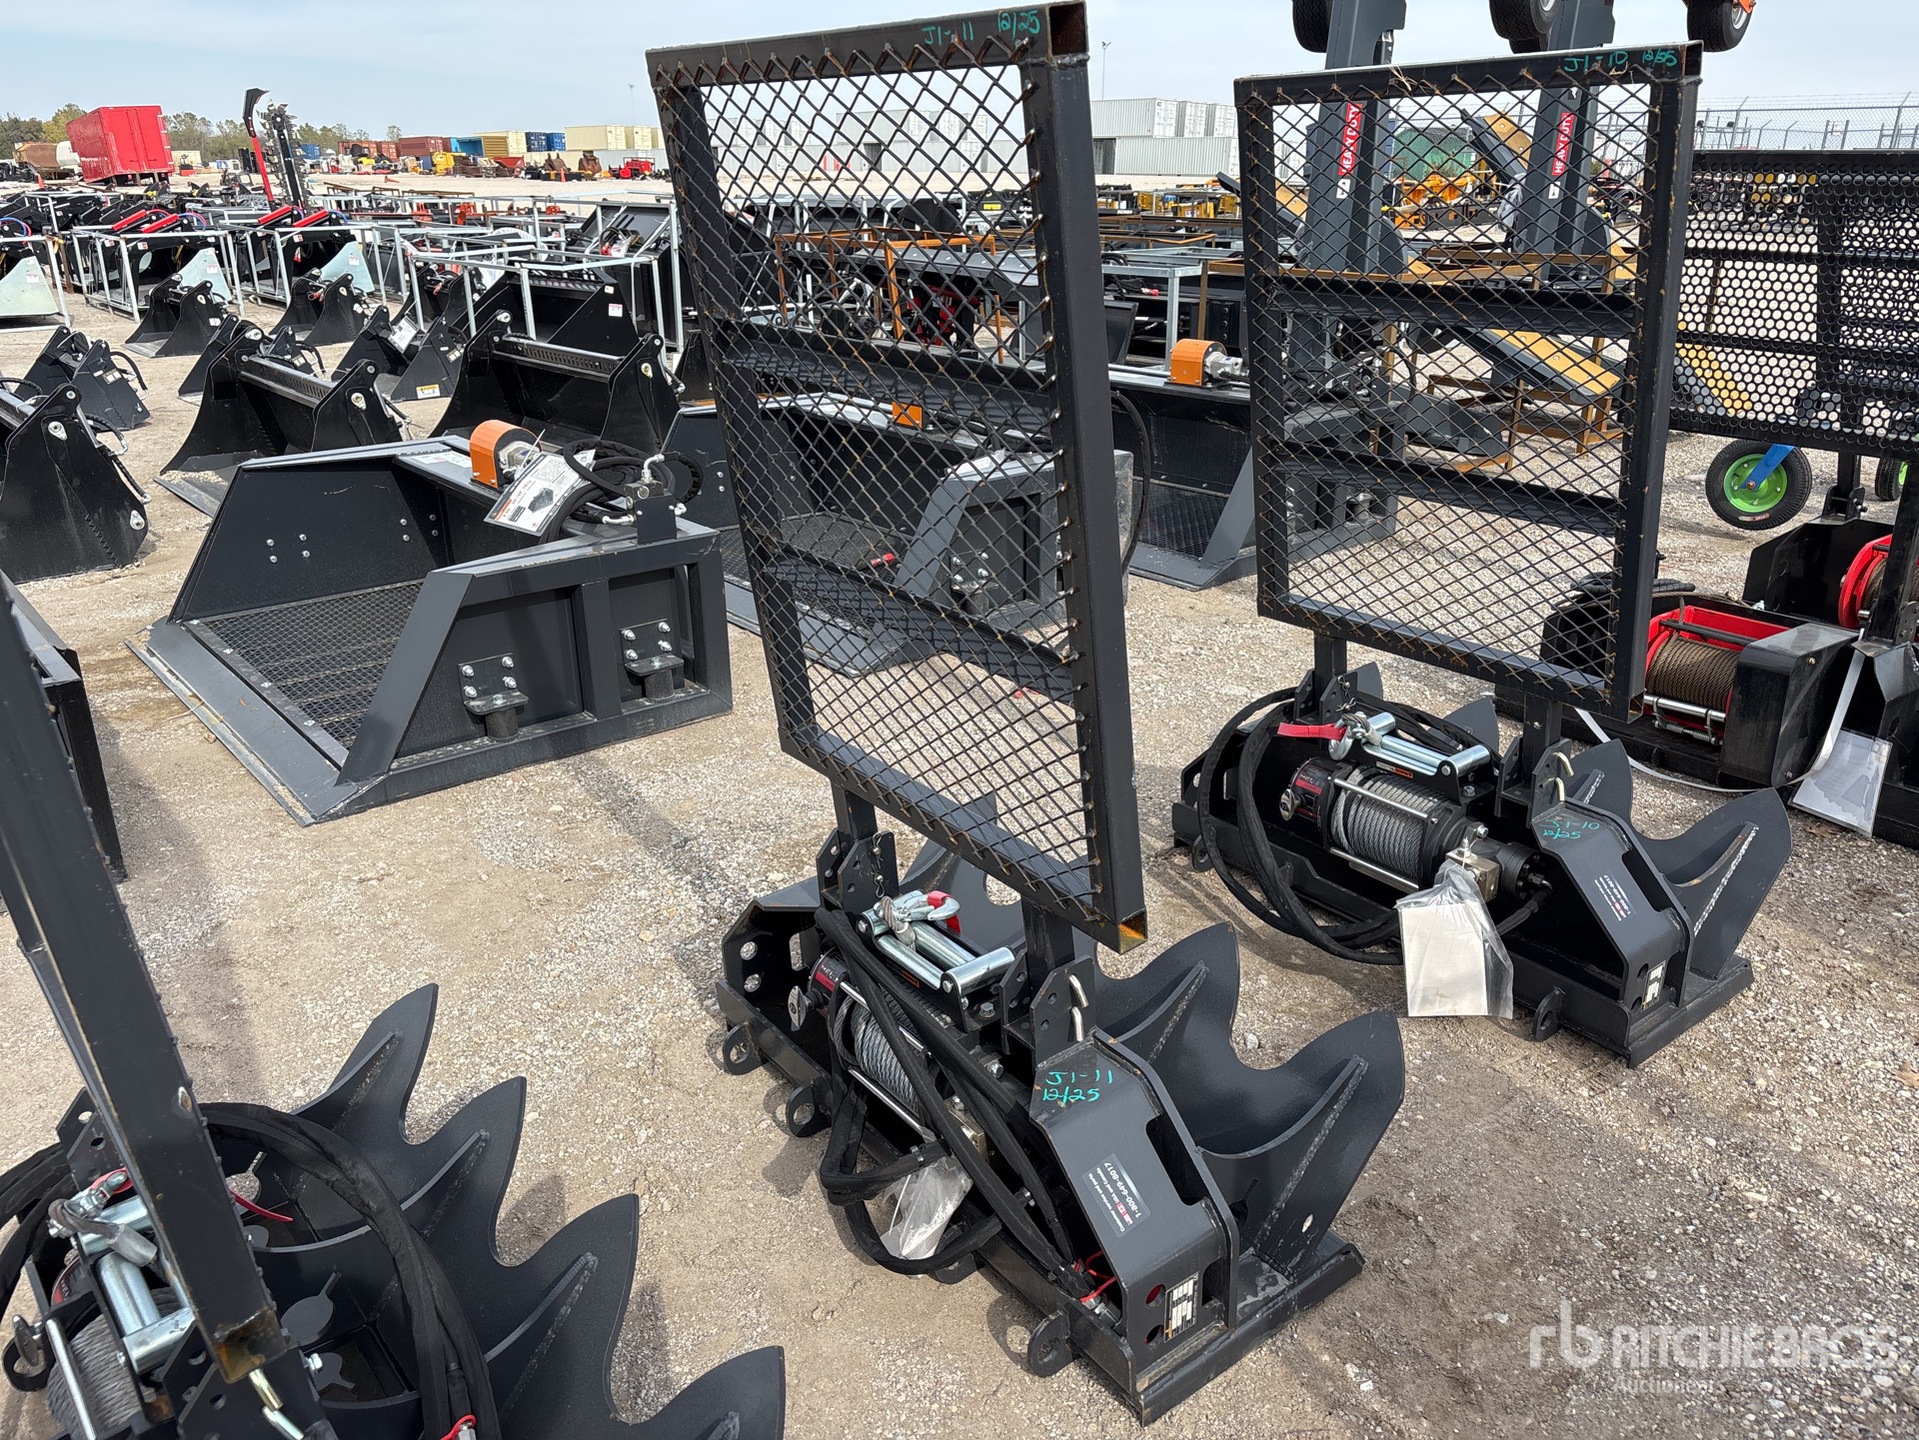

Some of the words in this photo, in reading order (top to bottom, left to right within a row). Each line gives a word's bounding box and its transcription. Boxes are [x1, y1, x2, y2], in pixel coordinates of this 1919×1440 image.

[997, 9, 1041, 40] 12/25
[1044, 1069, 1115, 1085] J1-11
[1041, 1086, 1102, 1108] 12/25
[1104, 1162, 1142, 1218] 1-800-649-8017
